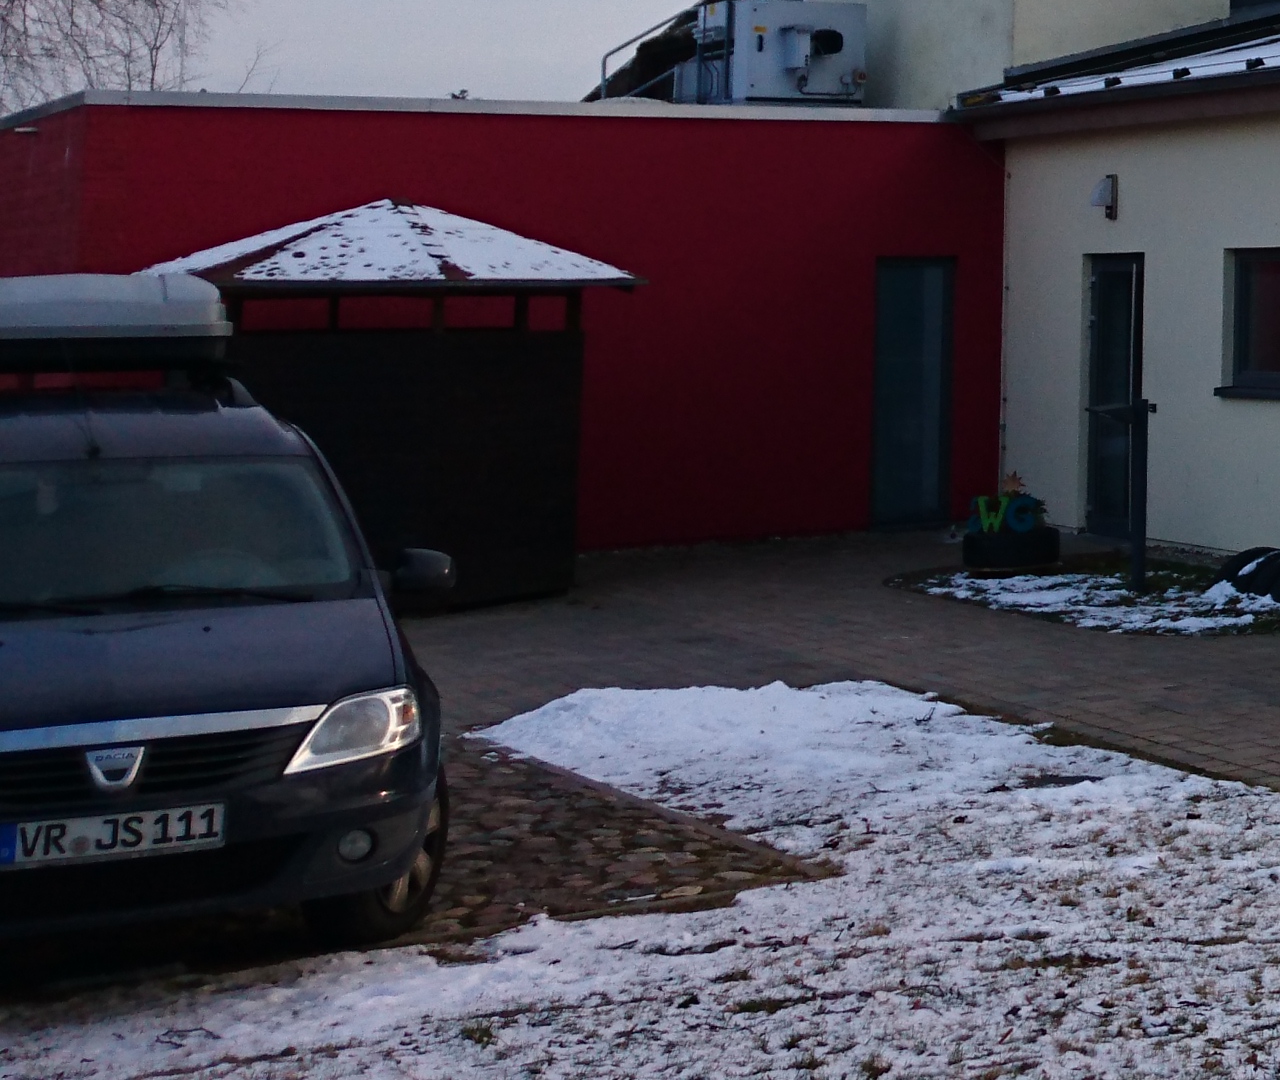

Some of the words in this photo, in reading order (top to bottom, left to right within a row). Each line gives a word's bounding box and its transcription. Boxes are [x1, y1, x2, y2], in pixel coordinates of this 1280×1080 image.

[94, 752, 135, 762] DACIA
[19, 823, 67, 858] VR
[95, 816, 145, 851] JS
[152, 807, 220, 845] 111
